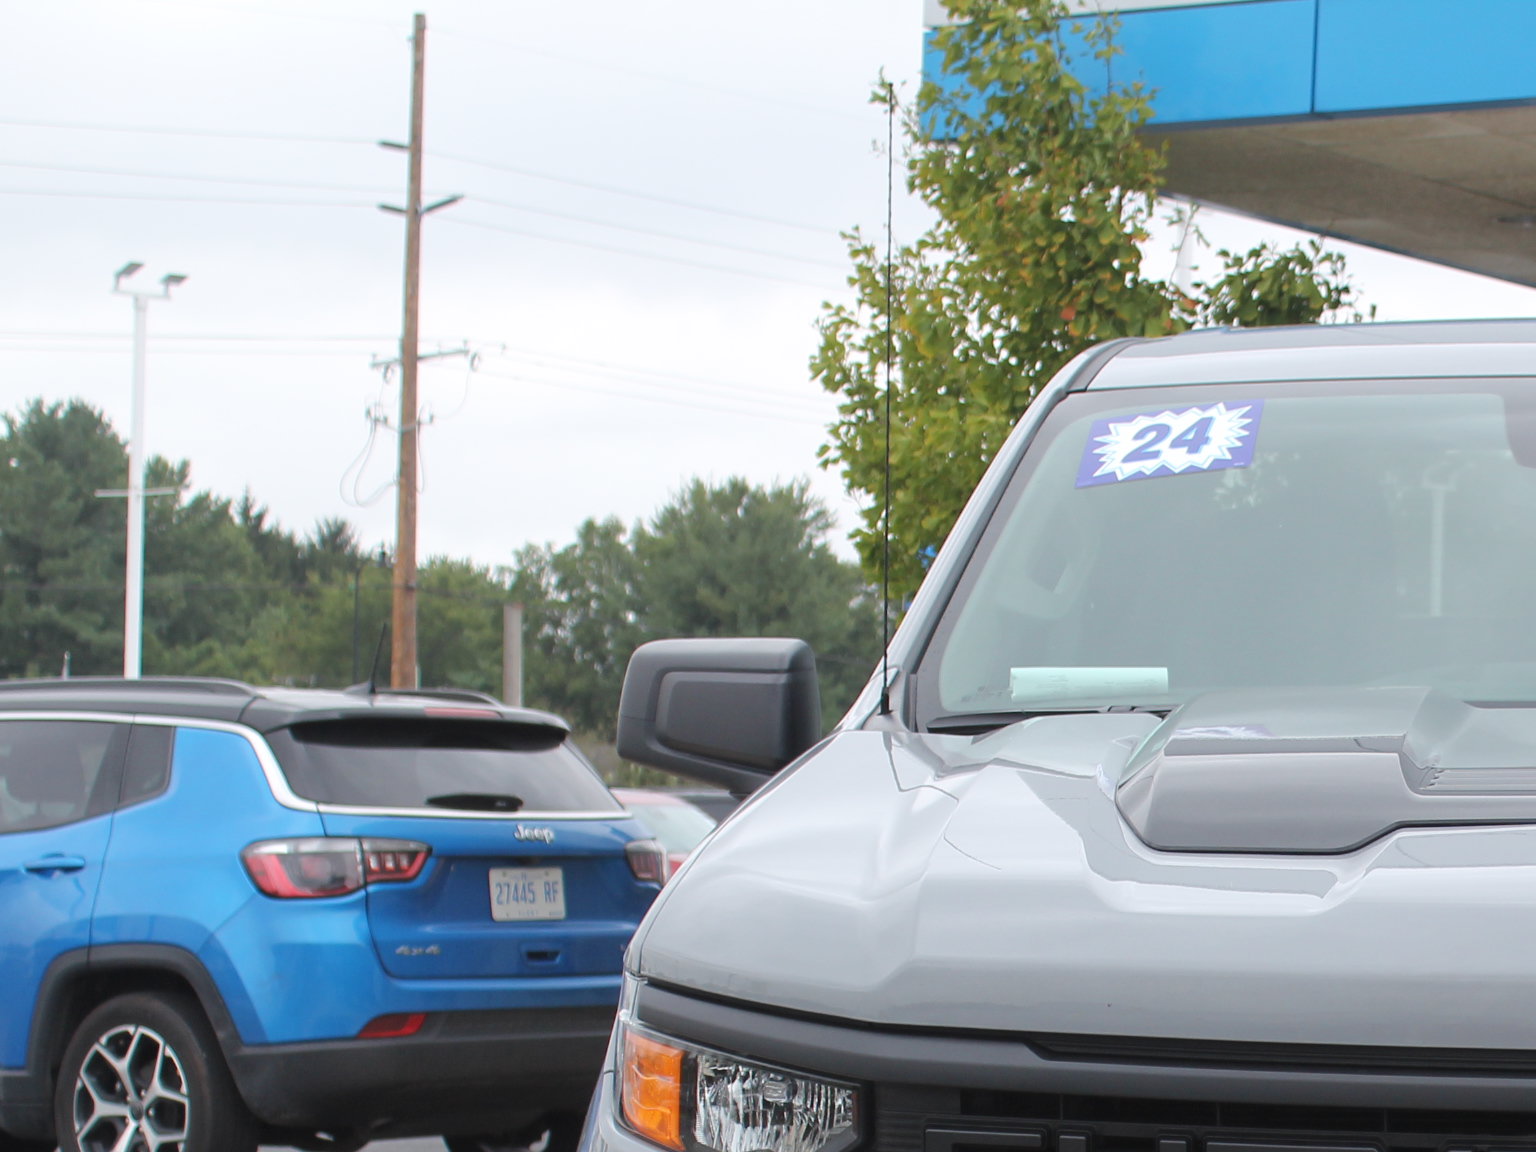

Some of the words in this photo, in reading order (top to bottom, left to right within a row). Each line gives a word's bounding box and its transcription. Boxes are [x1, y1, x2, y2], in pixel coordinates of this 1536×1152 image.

[1120, 416, 1216, 464] 24
[513, 823, 555, 845] Jeep
[495, 881, 536, 905] 27445
[543, 881, 559, 903] RF
